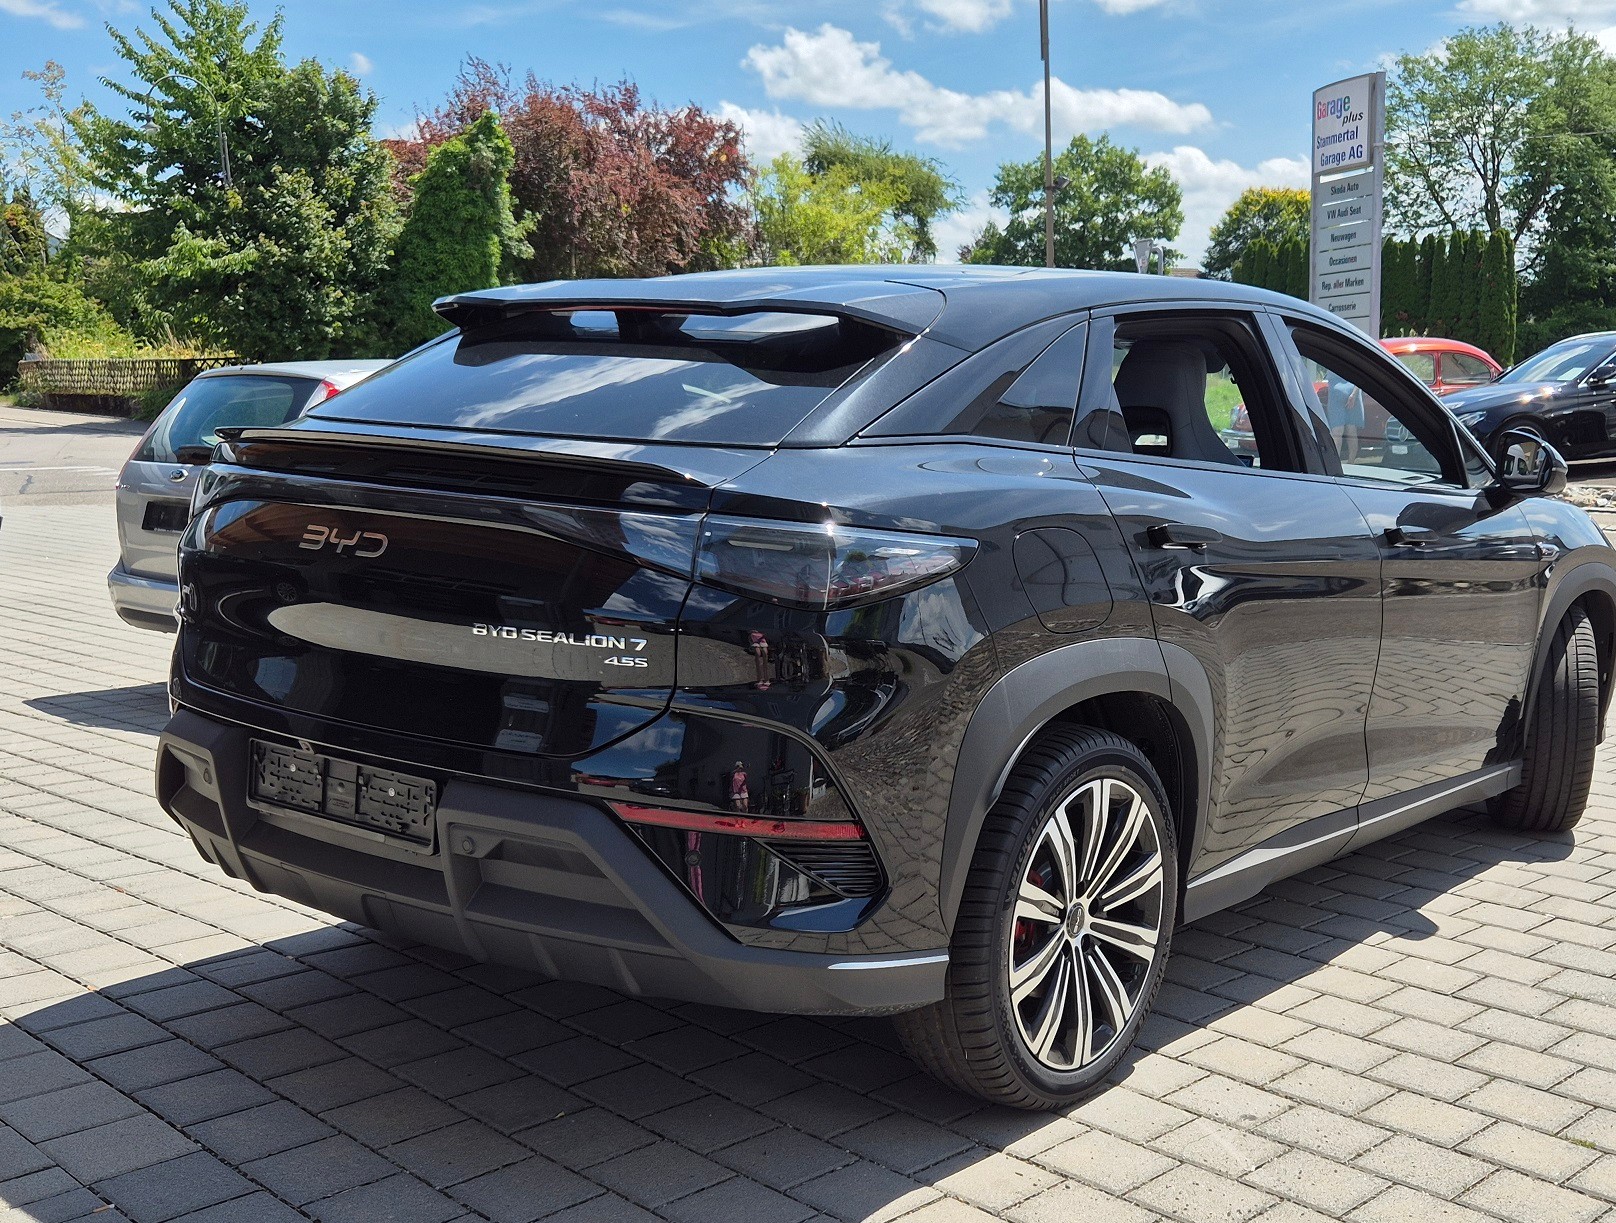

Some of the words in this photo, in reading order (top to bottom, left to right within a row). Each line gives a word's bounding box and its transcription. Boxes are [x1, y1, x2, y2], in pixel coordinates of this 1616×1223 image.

[1317, 96, 1350, 120] Garage
[1342, 111, 1364, 127] plus
[1316, 125, 1359, 149] Stammertal
[1320, 151, 1346, 166] Garage
[1348, 144, 1363, 160] AG
[1346, 182, 1359, 192] Auto
[1327, 210, 1336, 220] VW
[1337, 207, 1348, 218] Audi
[1349, 205, 1361, 216] Seat
[1330, 231, 1357, 243] Neuwagen
[1329, 255, 1357, 267] Occasionen
[1321, 281, 1332, 291] Rep.
[1333, 280, 1344, 289] aller
[1344, 277, 1364, 288] Marken
[299, 524, 389, 558] BYD
[472, 622, 518, 640] BYD
[520, 628, 626, 650] SEALION
[629, 637, 648, 651] 7
